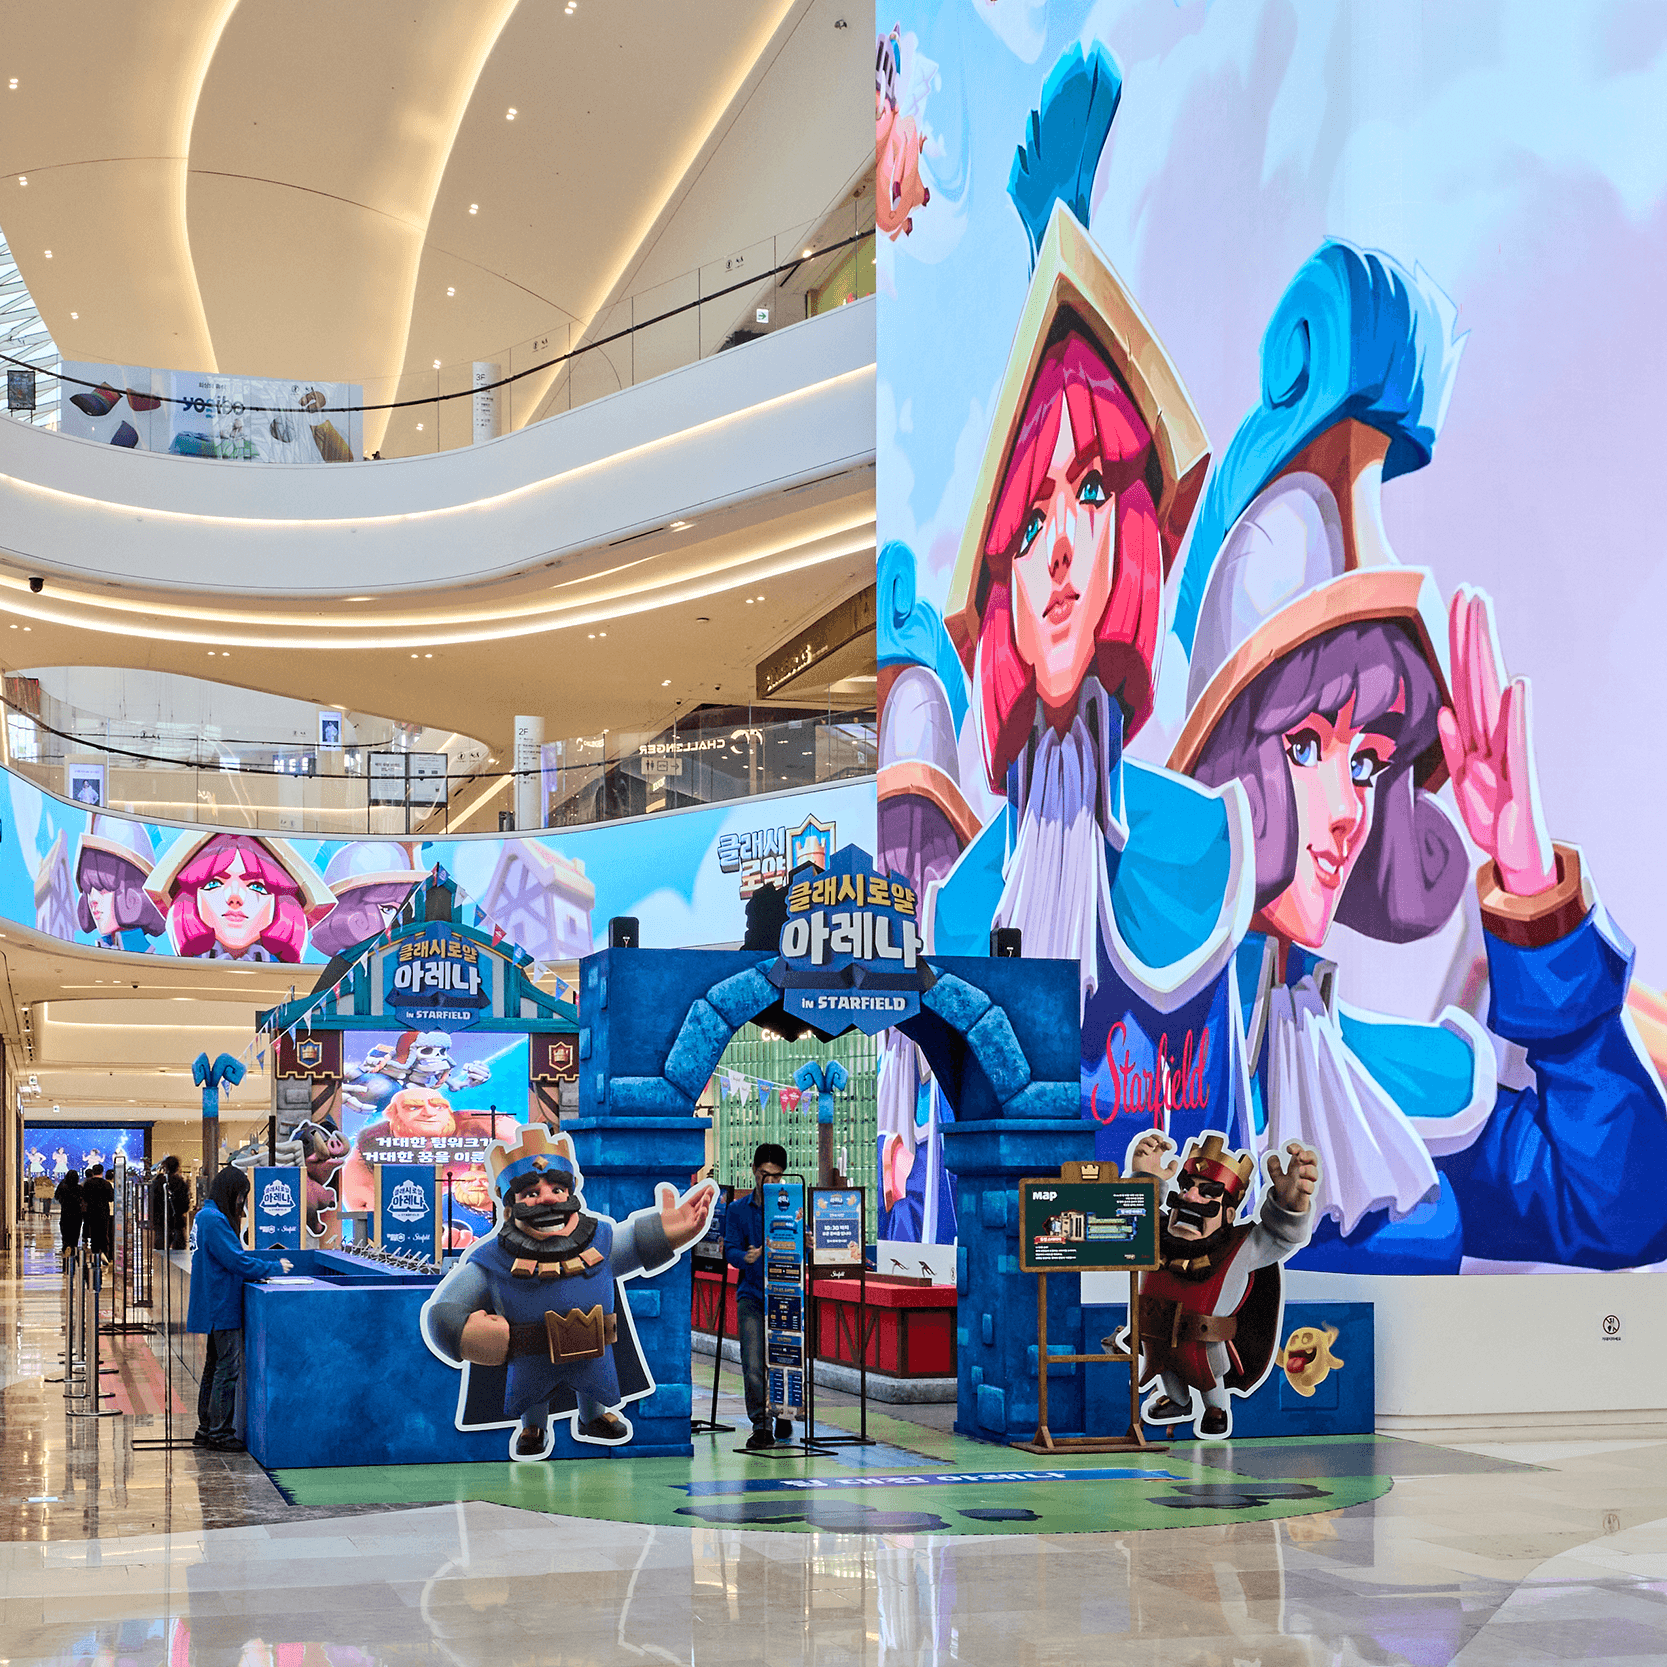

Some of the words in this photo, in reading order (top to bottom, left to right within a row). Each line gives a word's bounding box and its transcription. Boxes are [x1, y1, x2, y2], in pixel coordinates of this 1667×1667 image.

[518, 728, 529, 736] 2F
[718, 826, 786, 873] 클래시
[787, 873, 918, 916] 클래시로얄
[781, 910, 924, 969] 아레나
[399, 938, 478, 964] 클래시로얄
[393, 960, 482, 996] 아레나
[817, 995, 907, 1011] STARFIELD
[416, 1010, 472, 1020] STARFIELD
[1090, 1020, 1210, 1132] Starfield
[375, 1136, 428, 1149] 거대한
[430, 1136, 493, 1149] 팀워크가
[362, 1150, 415, 1163] 거대한
[417, 1150, 450, 1164] 꿈을
[264, 1192, 291, 1203] 아레나
[392, 1195, 424, 1207] 아레나
[936, 1472, 1067, 1482] 아레나
